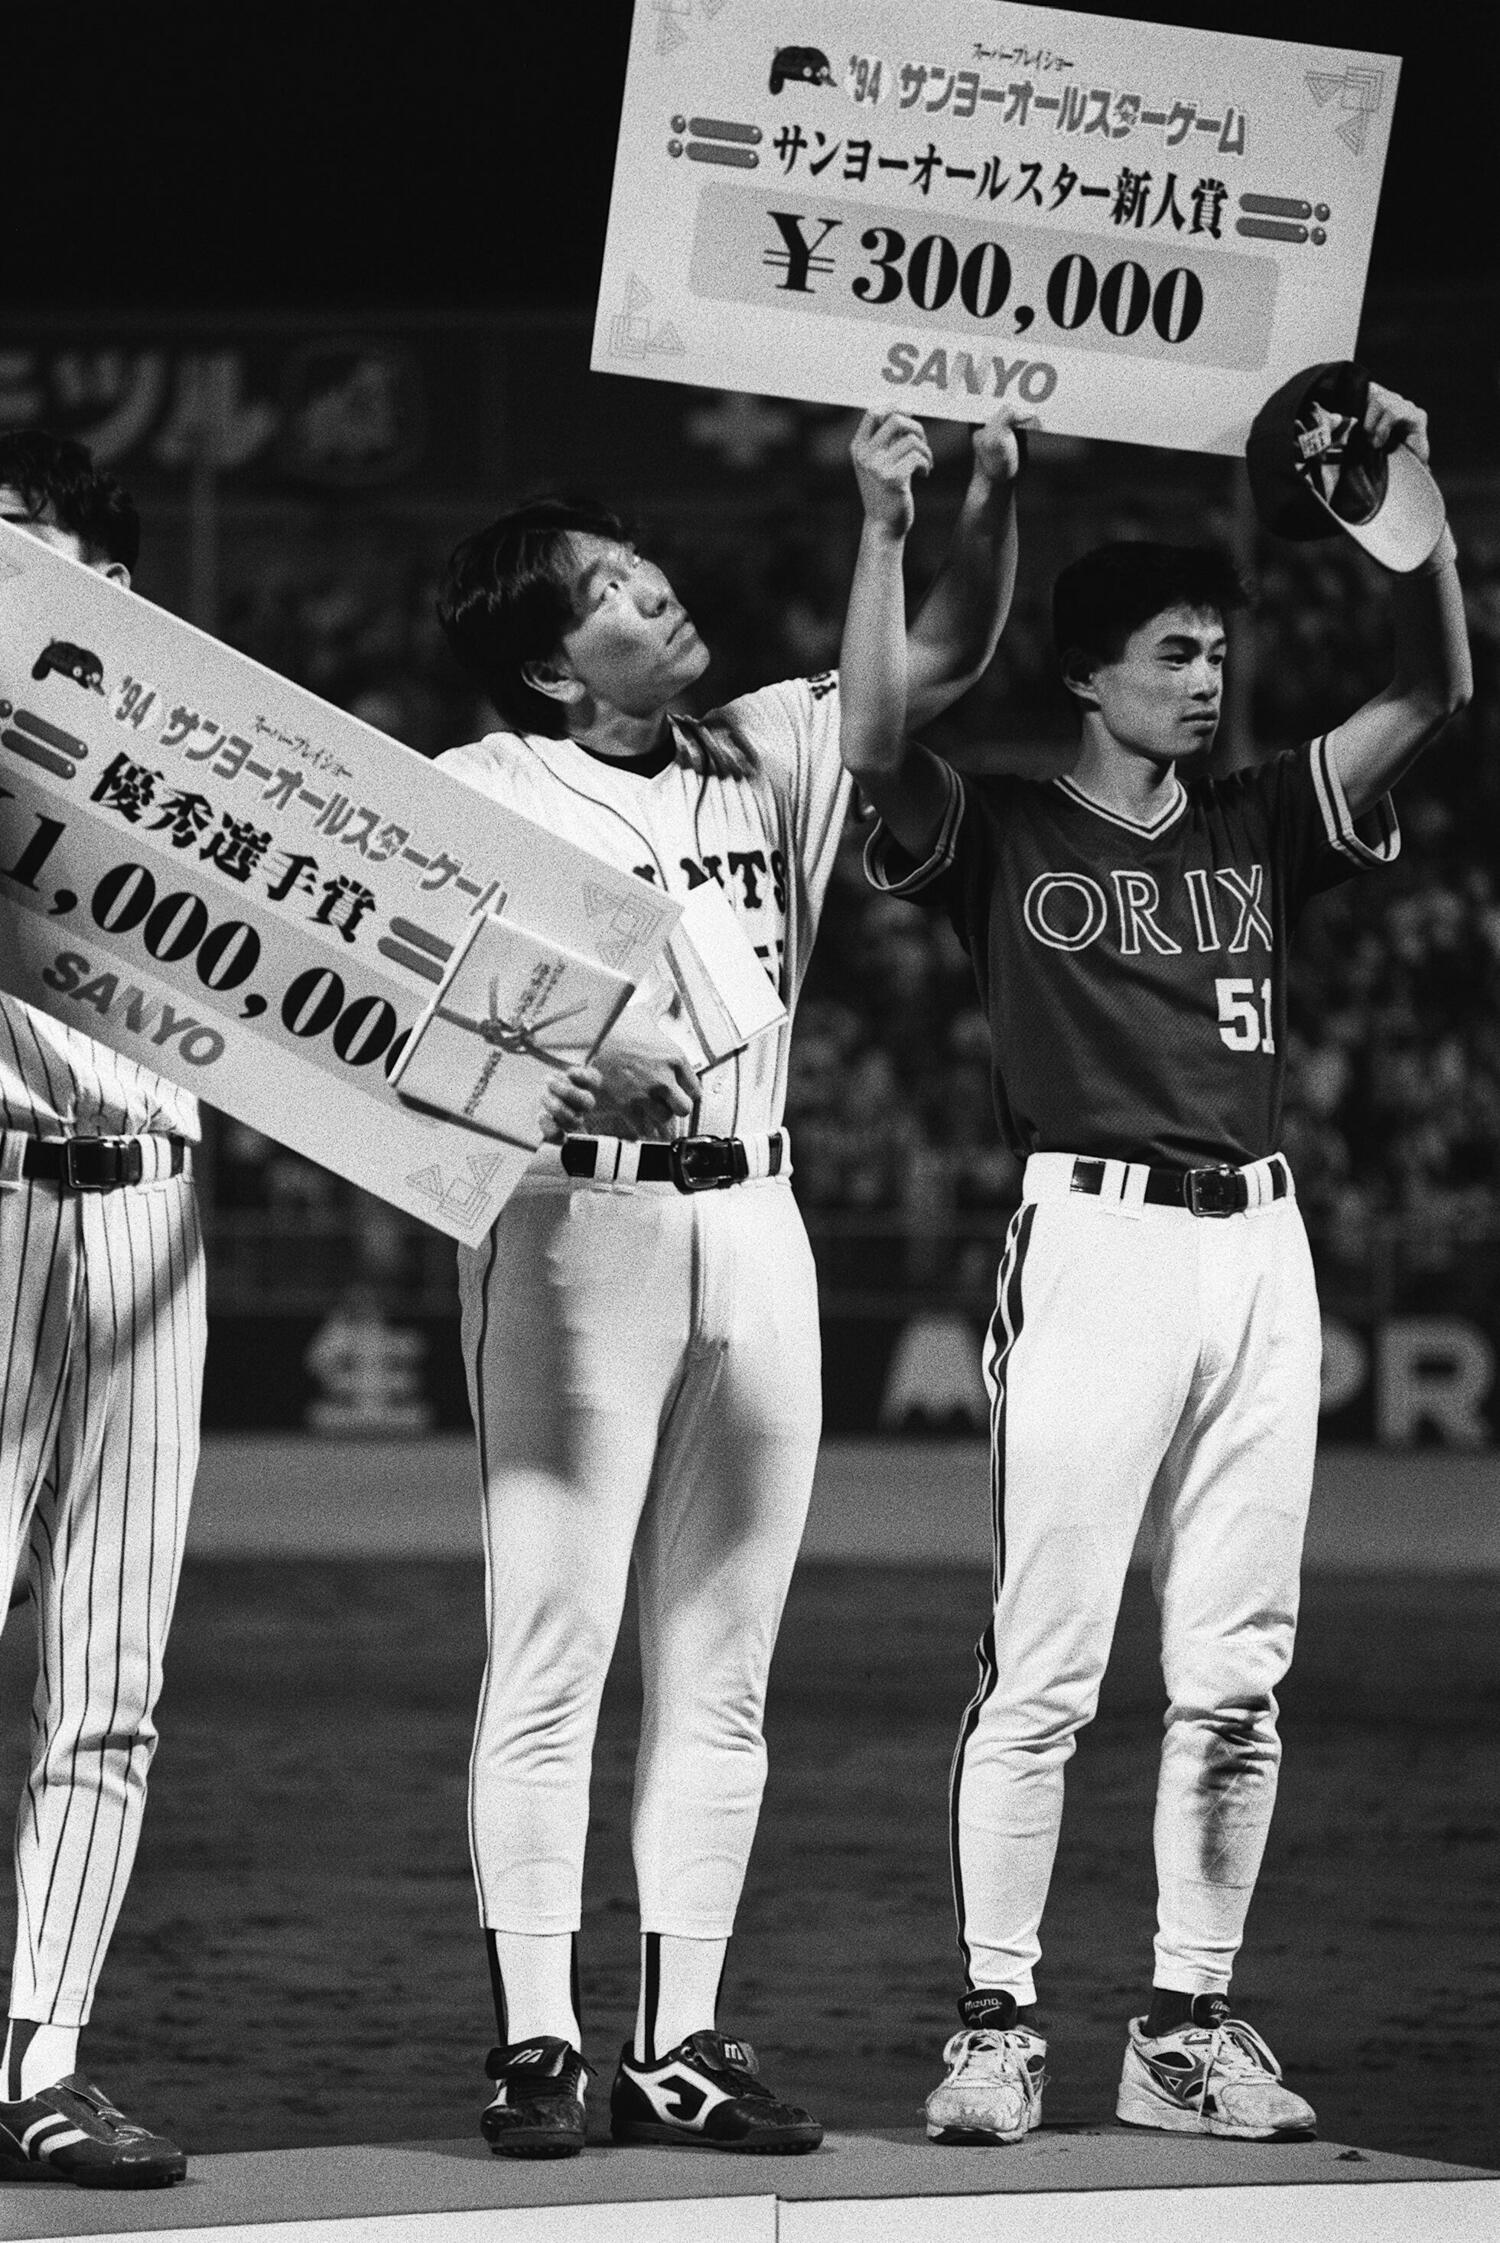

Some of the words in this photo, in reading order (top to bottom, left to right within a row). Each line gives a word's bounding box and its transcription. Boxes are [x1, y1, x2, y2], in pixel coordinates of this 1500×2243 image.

[900, 62, 1246, 156] サンヨーオールスターゲーム
[772, 124, 1229, 240] サンヨーオールスター新人賞
[881, 341, 1059, 404] SANYO
[89, 752, 377, 944] 優秀選手賞
[0, 786, 414, 1079] 1,000,00
[1023, 864, 1273, 955] ORIX
[41, 951, 226, 1066] SANYO
[1214, 977, 1276, 1055] 51
